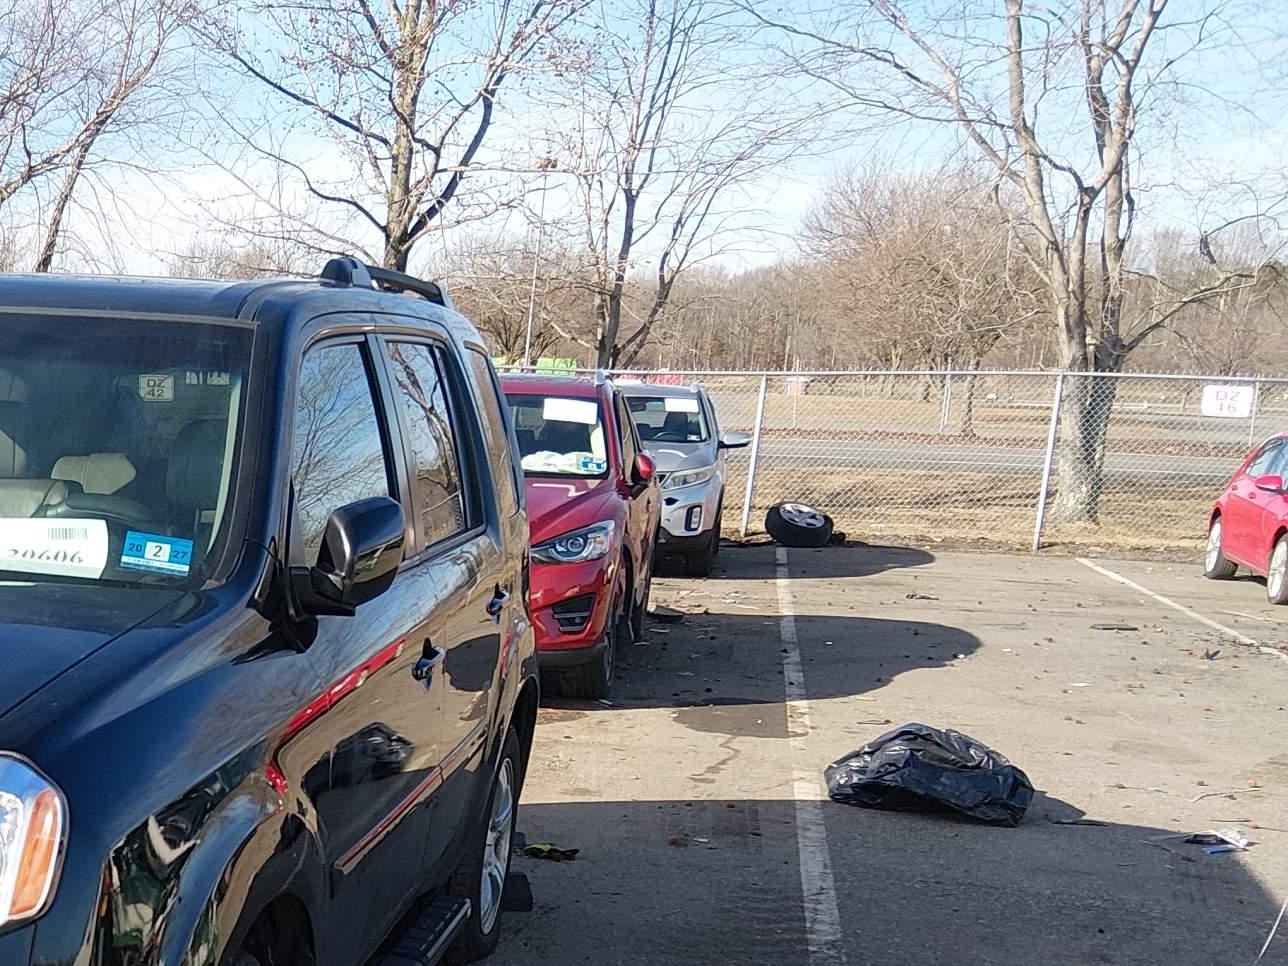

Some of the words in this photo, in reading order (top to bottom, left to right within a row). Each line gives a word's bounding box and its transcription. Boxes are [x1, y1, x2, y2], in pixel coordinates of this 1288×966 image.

[146, 378, 166, 388] DZ
[147, 388, 165, 398] 42
[1216, 390, 1240, 402] DZ
[128, 543, 143, 553] 20
[152, 544, 163, 558] 2
[172, 550, 188, 560] 27
